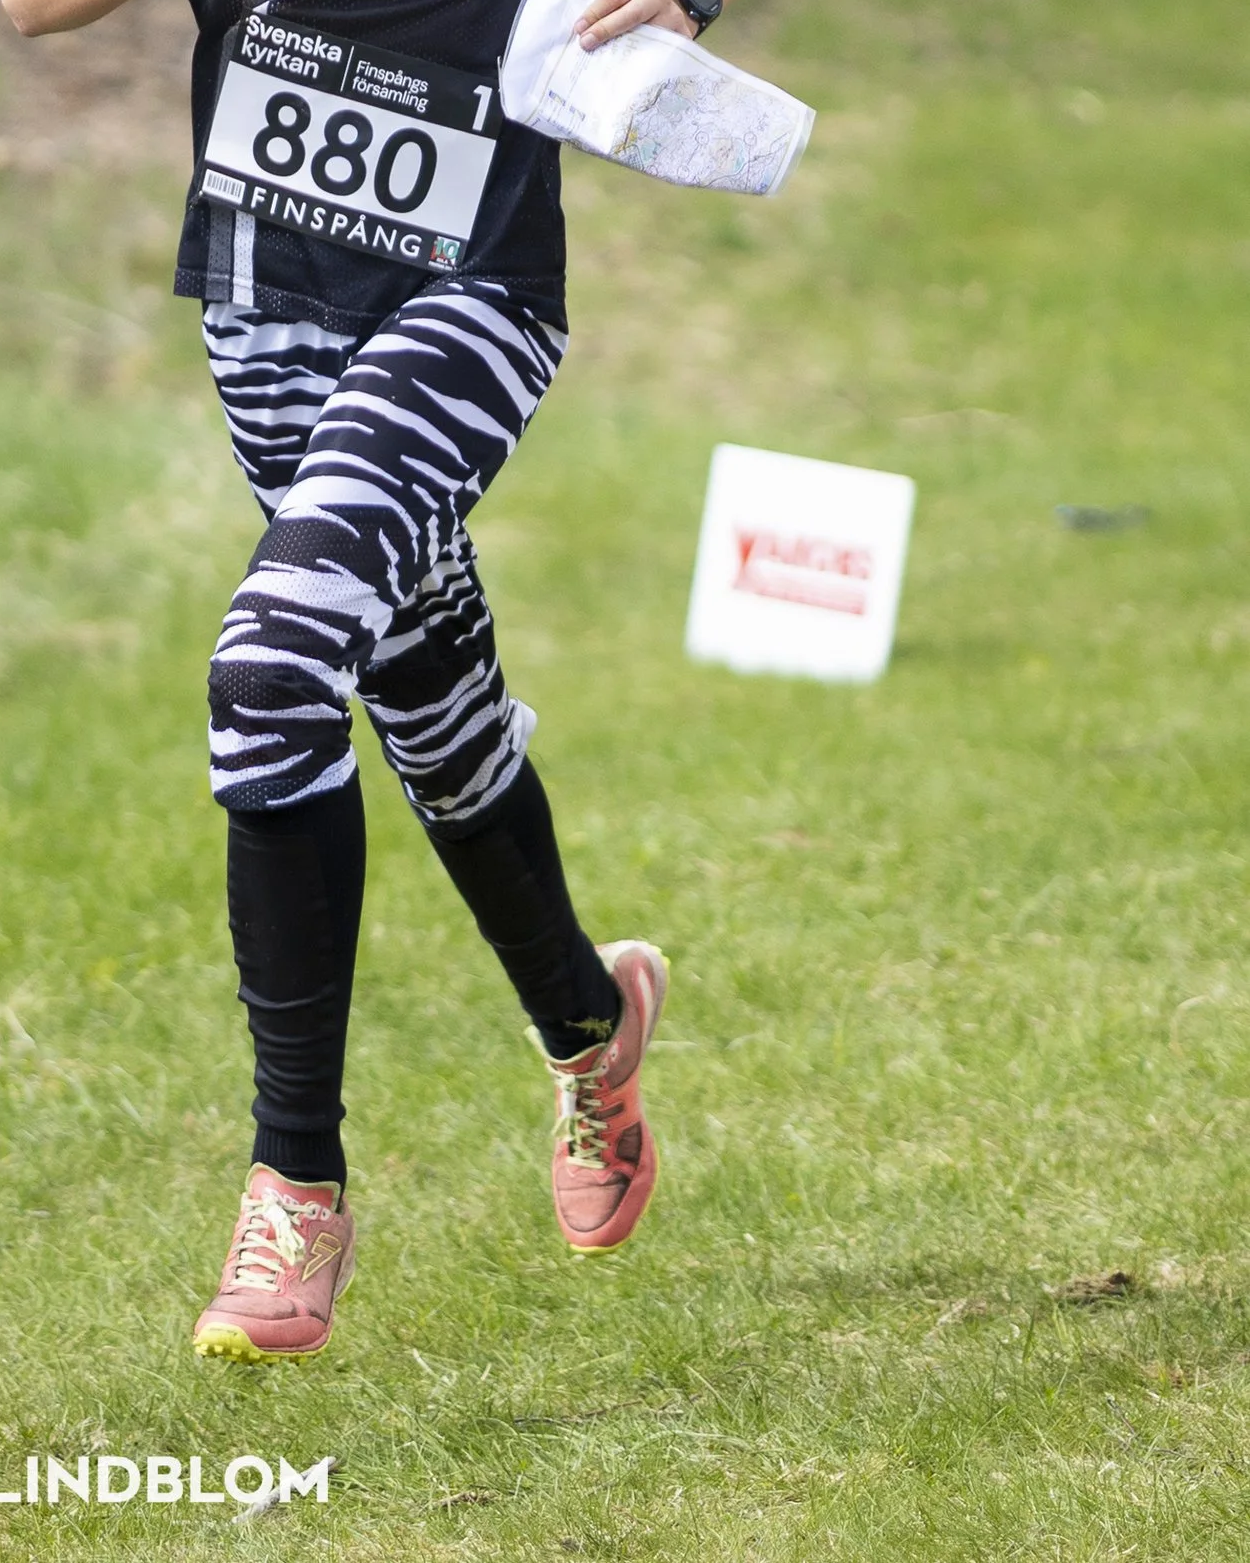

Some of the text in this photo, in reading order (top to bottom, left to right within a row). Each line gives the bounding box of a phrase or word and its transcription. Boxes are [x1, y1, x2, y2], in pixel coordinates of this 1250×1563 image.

[240, 35, 319, 79] kyrkan
[246, 14, 342, 63] Svenska
[352, 75, 429, 113] församling
[356, 60, 429, 94] Finspångs
[252, 90, 438, 214] 880
[251, 187, 422, 258] FINSPÅNG
